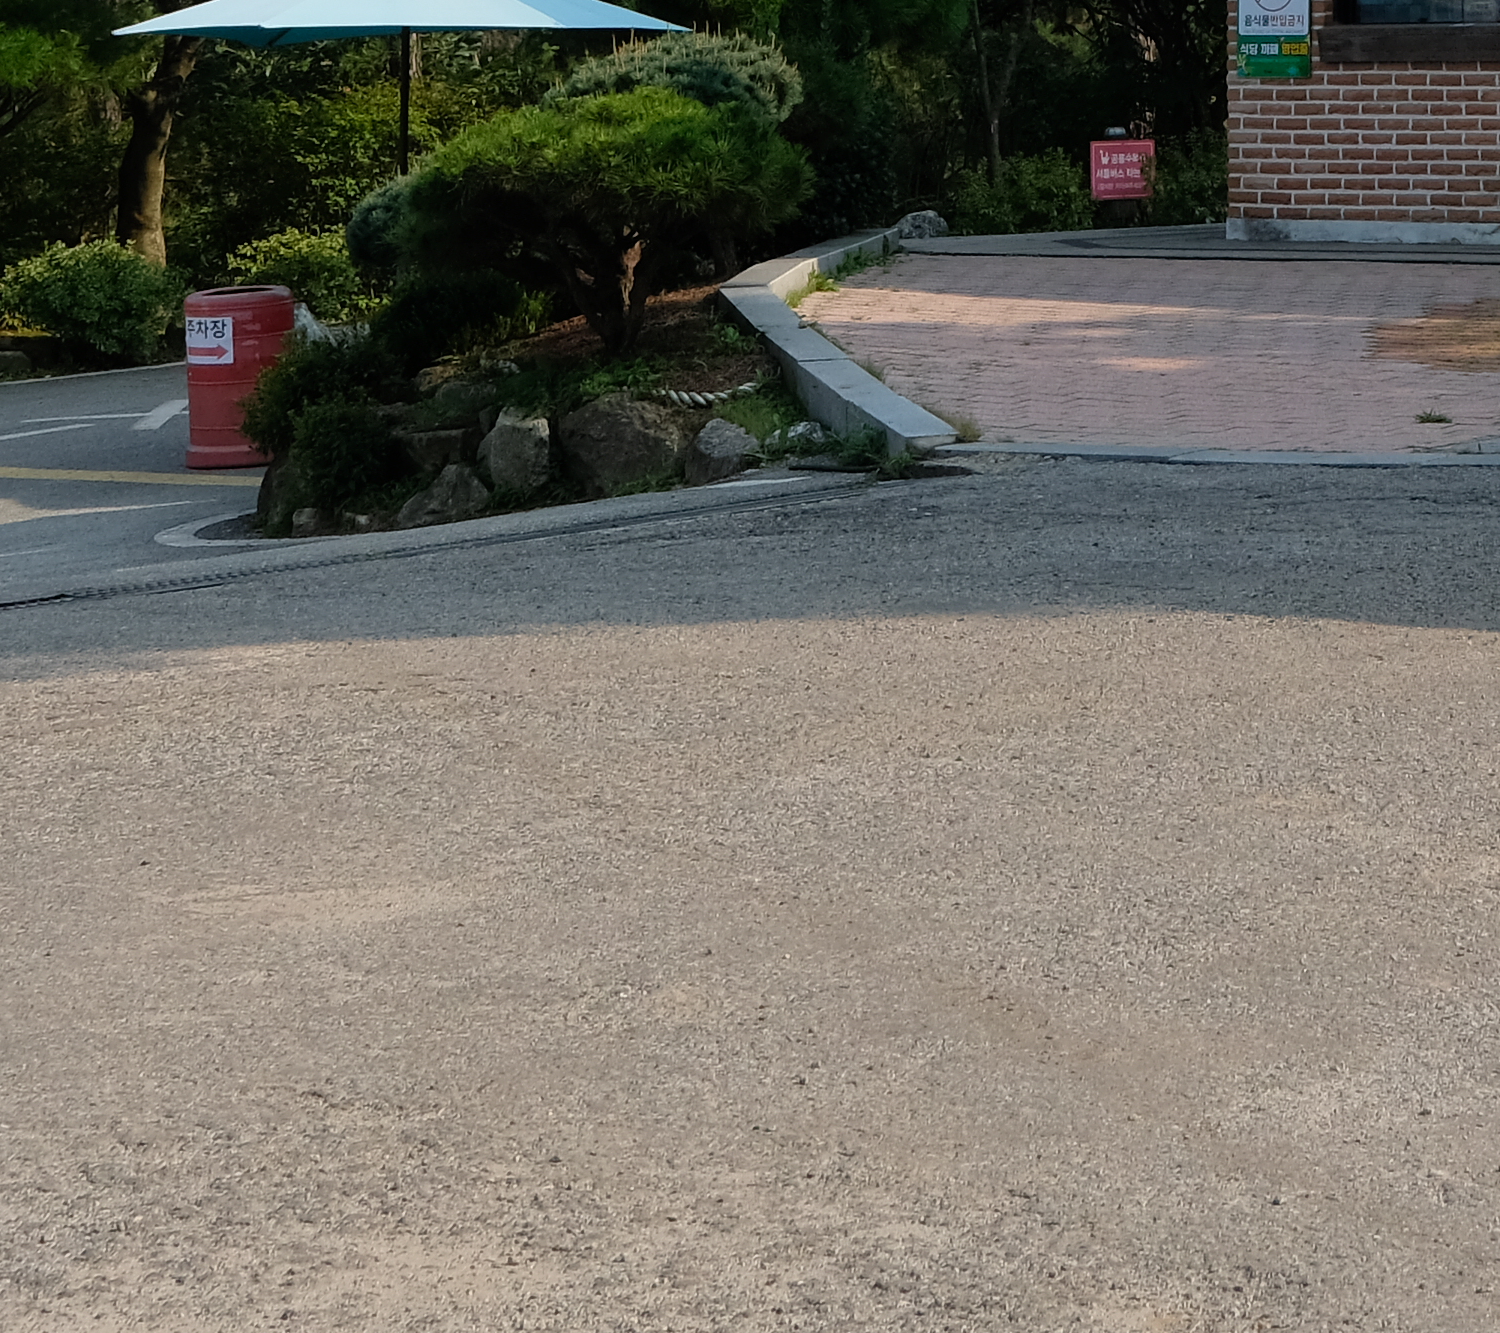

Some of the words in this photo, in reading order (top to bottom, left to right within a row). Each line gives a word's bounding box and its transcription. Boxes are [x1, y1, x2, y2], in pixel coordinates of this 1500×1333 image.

[1244, 14, 1305, 27] 음식물반입금지
[1240, 43, 1259, 56] 식당
[187, 319, 228, 340] 주차장
